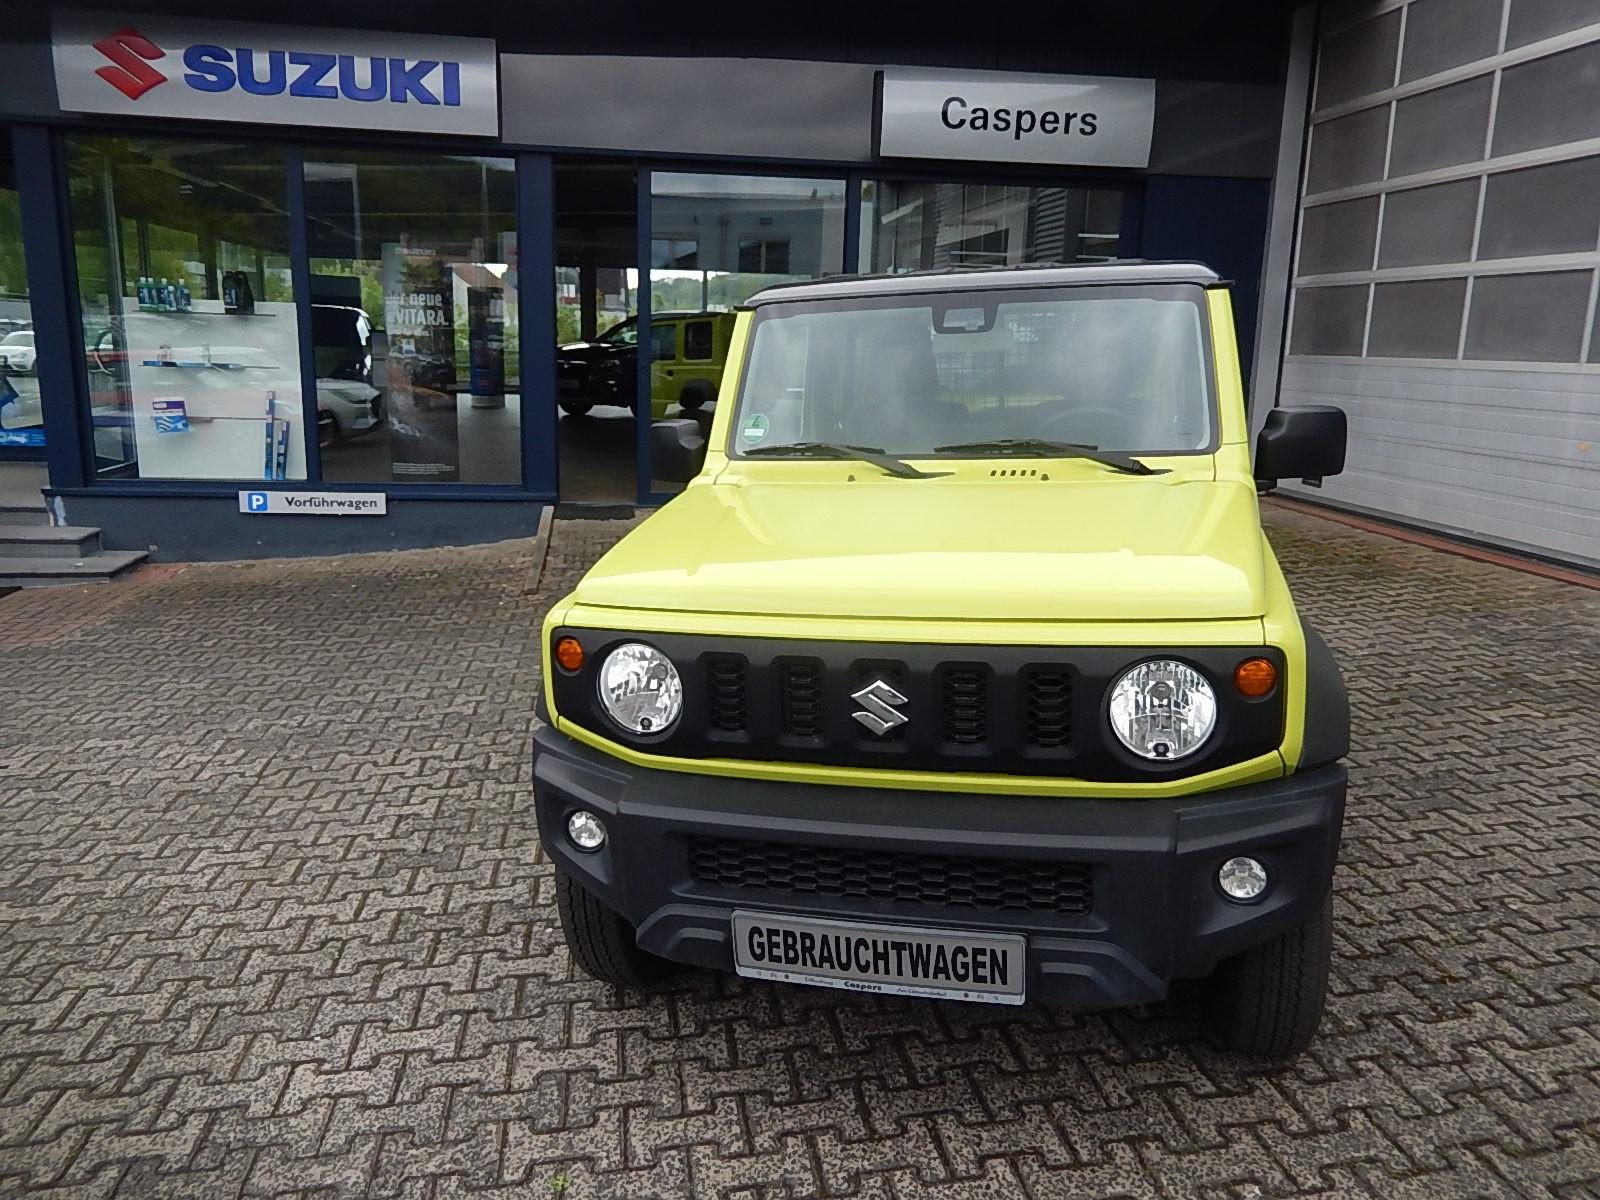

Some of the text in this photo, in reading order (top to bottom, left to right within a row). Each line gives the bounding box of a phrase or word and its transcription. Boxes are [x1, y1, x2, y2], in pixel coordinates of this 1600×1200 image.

[182, 44, 461, 107] SUZUKI
[941, 96, 1098, 140] Caspers
[409, 293, 443, 307] neue
[252, 494, 378, 511] P Vorführwagen
[748, 925, 1008, 986] GEBRAUCHTWAGEN
[844, 981, 882, 992] Caspers
